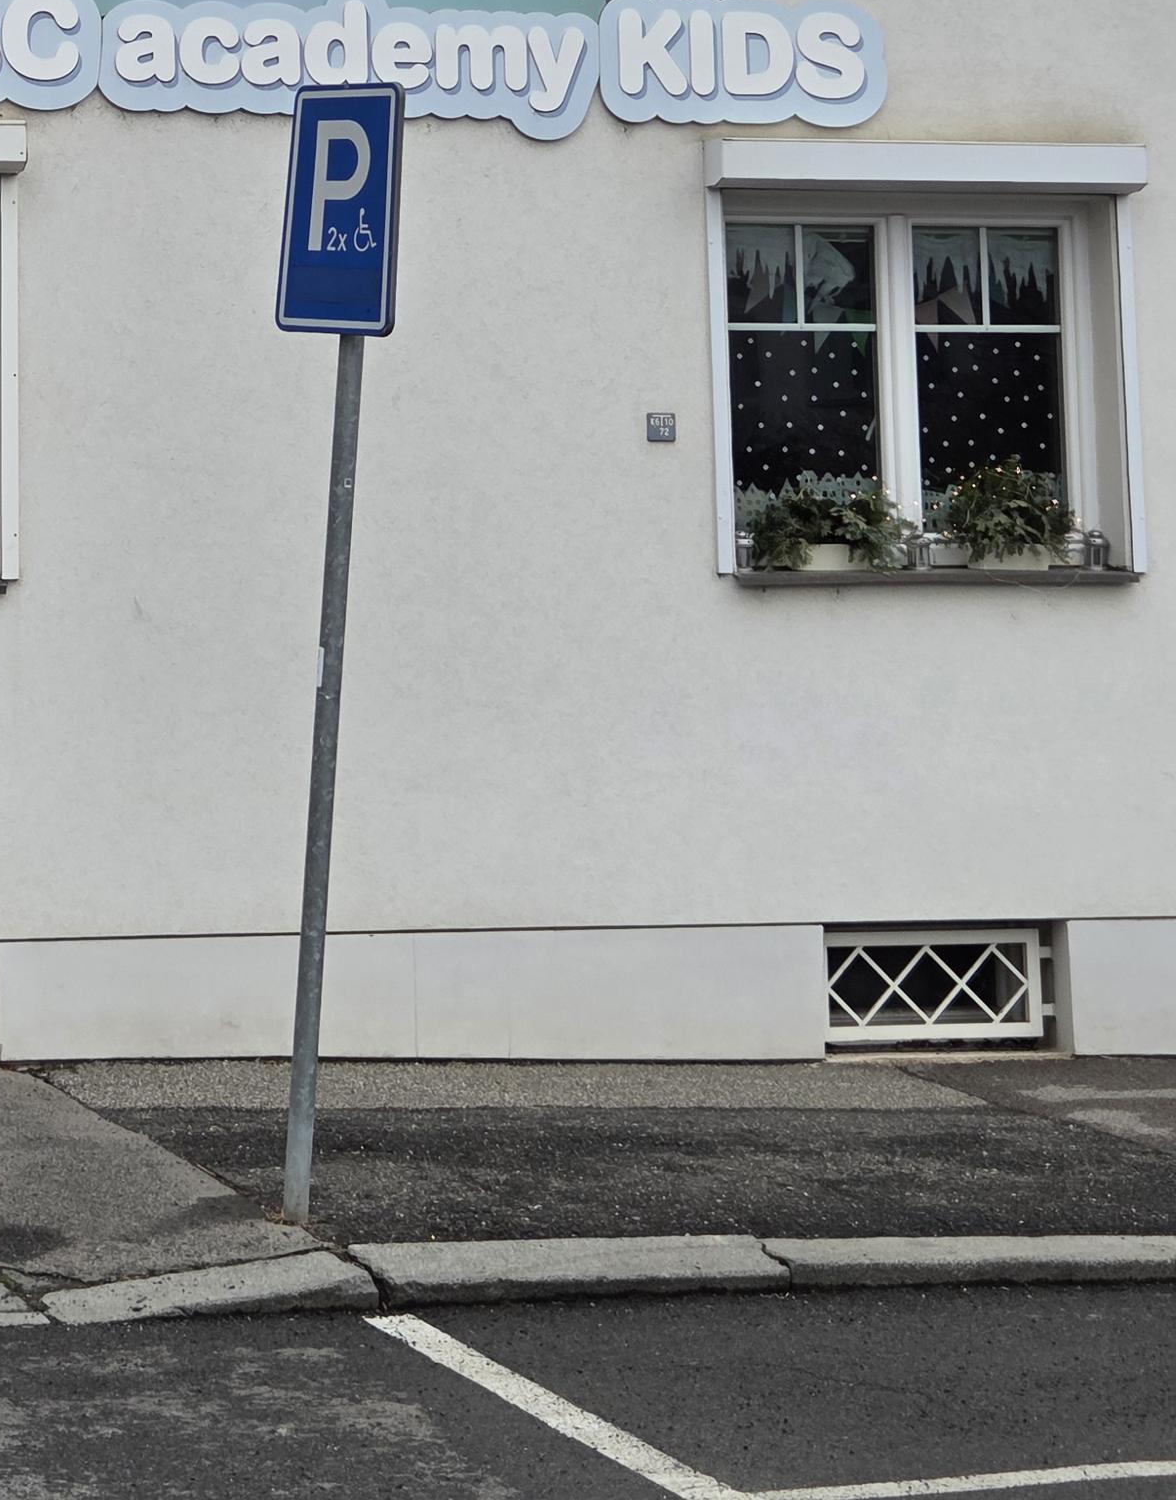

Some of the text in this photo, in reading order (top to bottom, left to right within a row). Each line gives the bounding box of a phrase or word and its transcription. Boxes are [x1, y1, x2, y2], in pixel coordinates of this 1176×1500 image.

[115, 0, 584, 112] academy
[618, 8, 865, 99] KIDS
[308, 119, 371, 251] P
[326, 226, 348, 251] 2x
